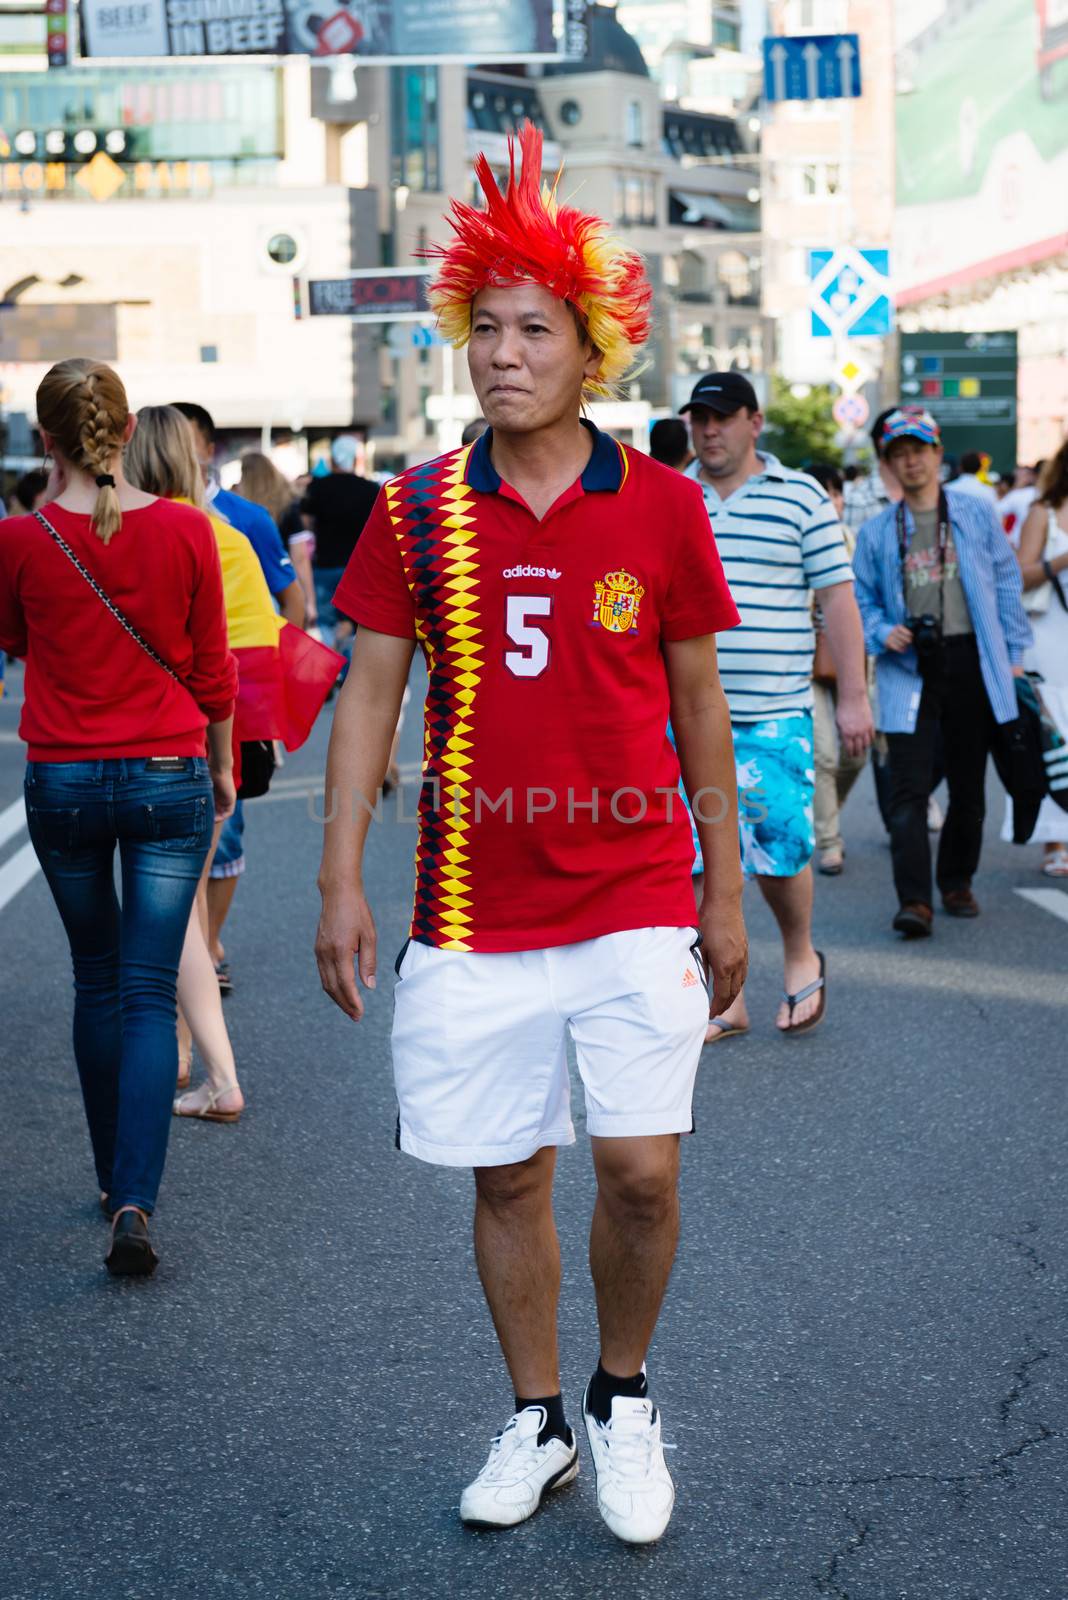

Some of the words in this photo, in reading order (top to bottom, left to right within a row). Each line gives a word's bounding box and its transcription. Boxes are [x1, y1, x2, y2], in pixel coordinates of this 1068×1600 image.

[169, 22, 206, 55] IN
[207, 16, 285, 53] BEEF
[502, 564, 546, 579] adidas
[505, 594, 551, 678] 5
